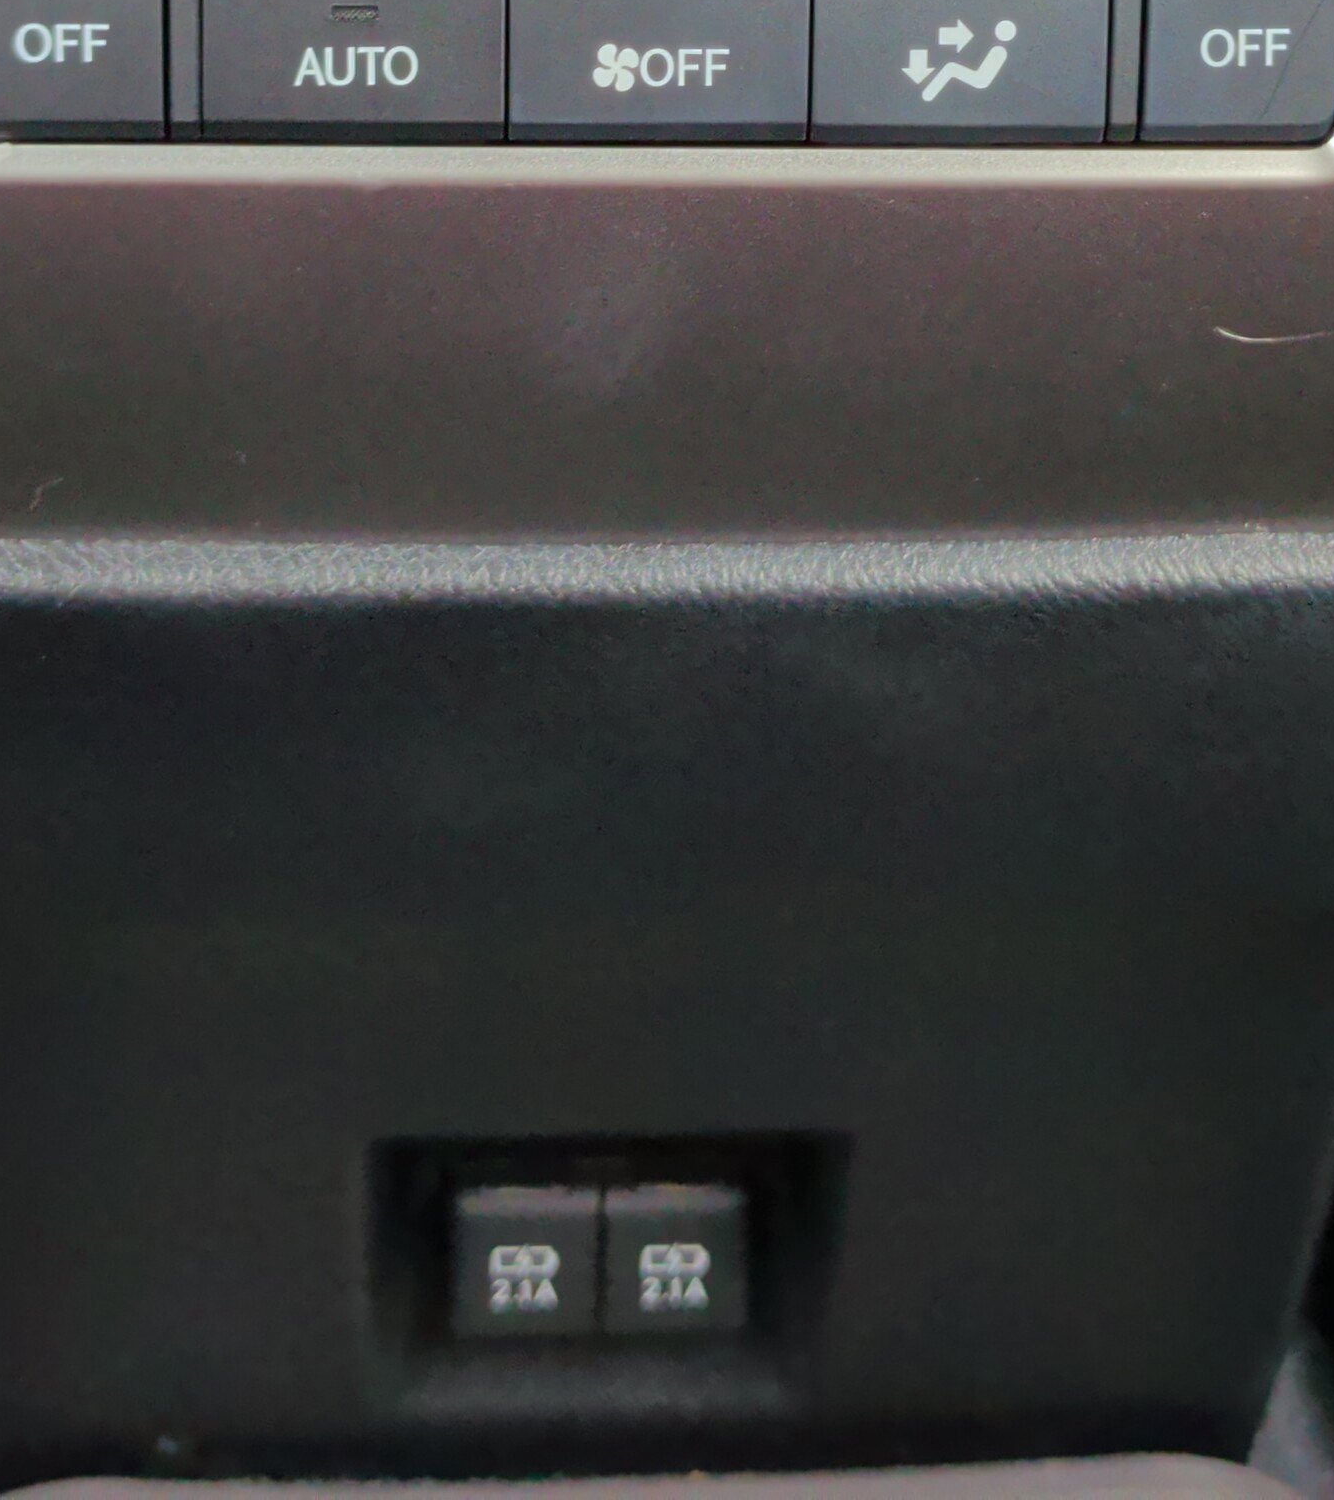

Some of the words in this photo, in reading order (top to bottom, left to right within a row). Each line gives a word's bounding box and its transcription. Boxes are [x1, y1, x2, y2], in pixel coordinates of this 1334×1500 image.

[13, 23, 110, 63] OFF
[1199, 28, 1292, 68] OFF
[293, 45, 419, 86] AUTO
[639, 47, 730, 87] OFF
